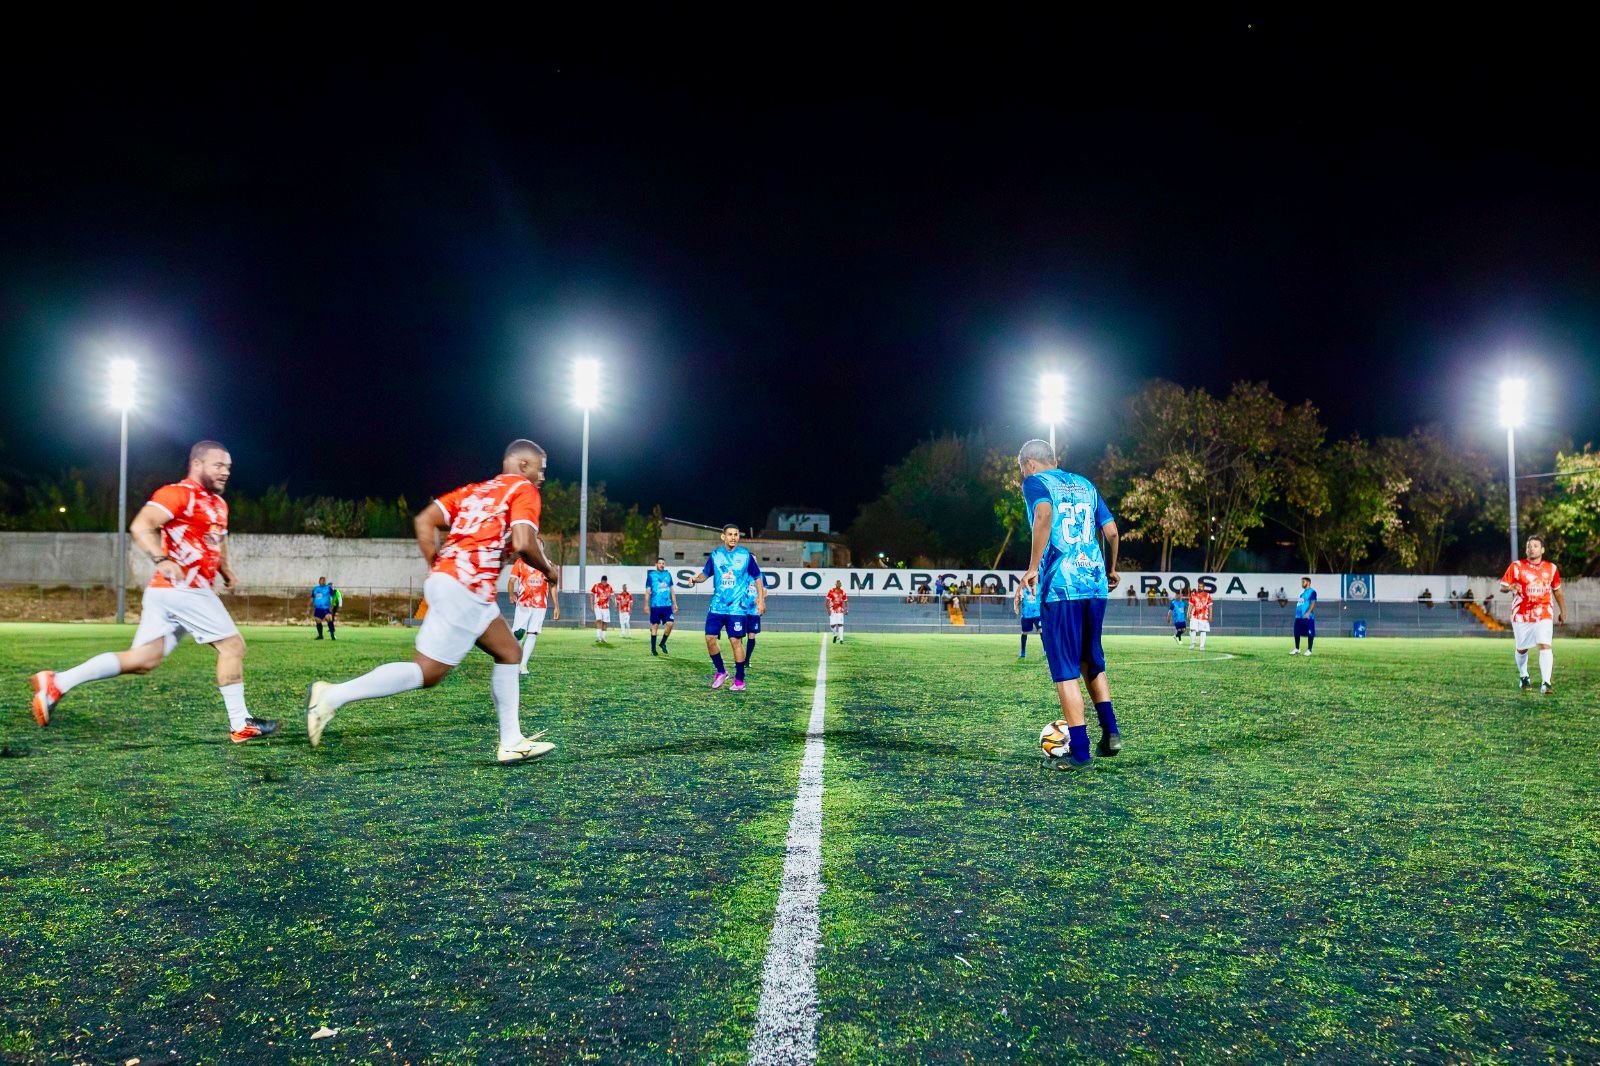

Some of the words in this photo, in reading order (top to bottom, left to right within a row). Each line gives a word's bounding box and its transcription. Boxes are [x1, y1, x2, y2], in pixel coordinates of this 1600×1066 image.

[1058, 502, 1092, 544] 27
[676, 569, 822, 590] SDIO
[1140, 575, 1247, 595] ROSA
